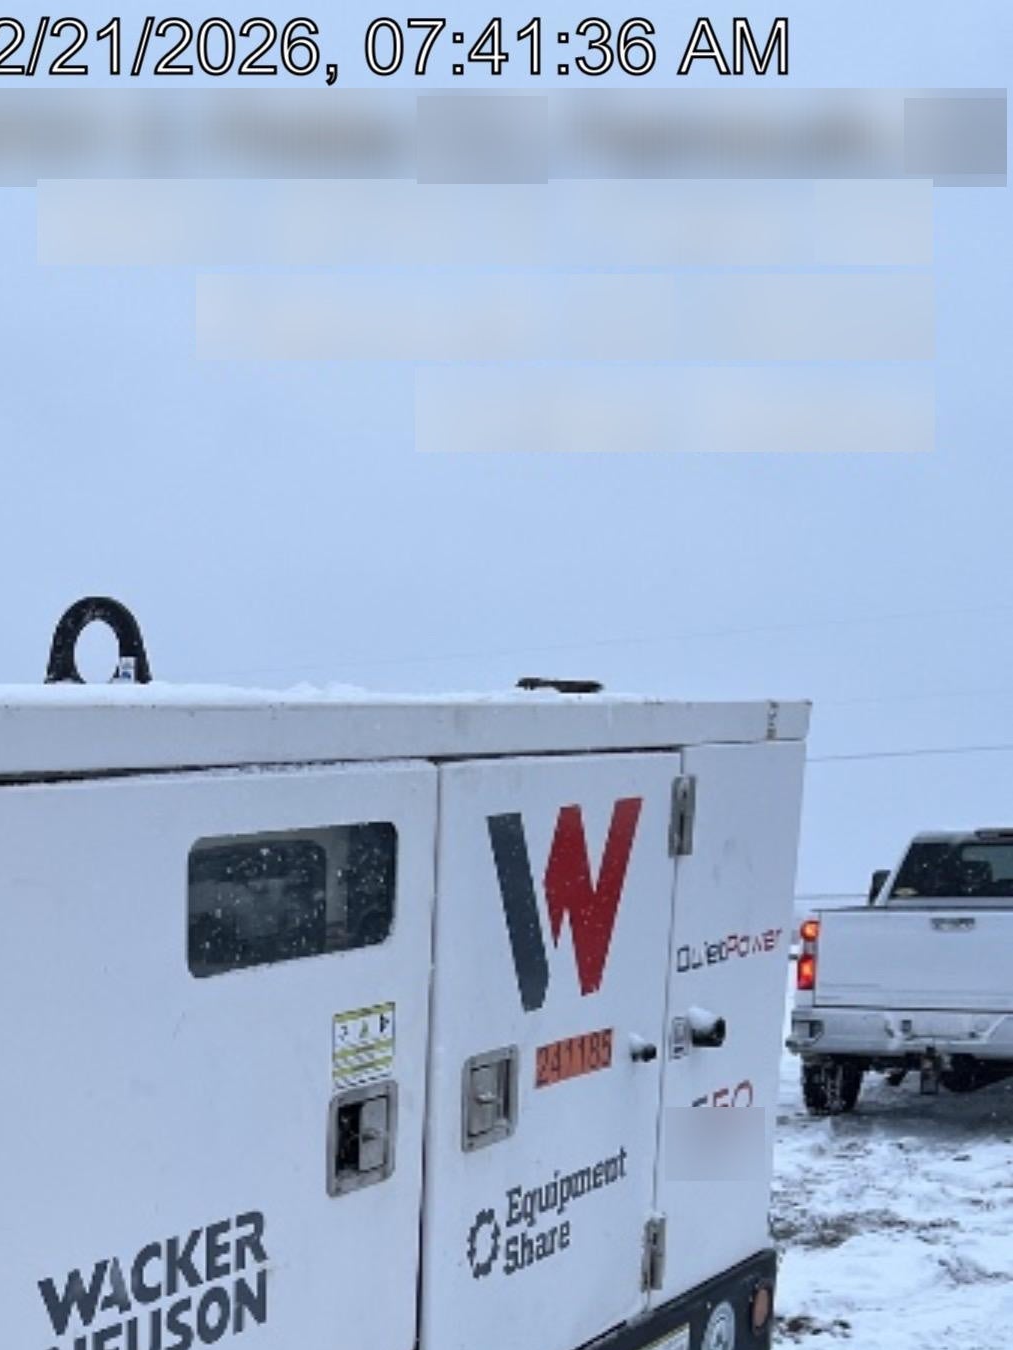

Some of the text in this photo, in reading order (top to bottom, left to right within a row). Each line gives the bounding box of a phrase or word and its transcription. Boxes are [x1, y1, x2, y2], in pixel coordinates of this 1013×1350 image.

[505, 1145, 628, 1228] Equipment
[37, 1210, 269, 1336] WACKER
[504, 1220, 571, 1275] Share
